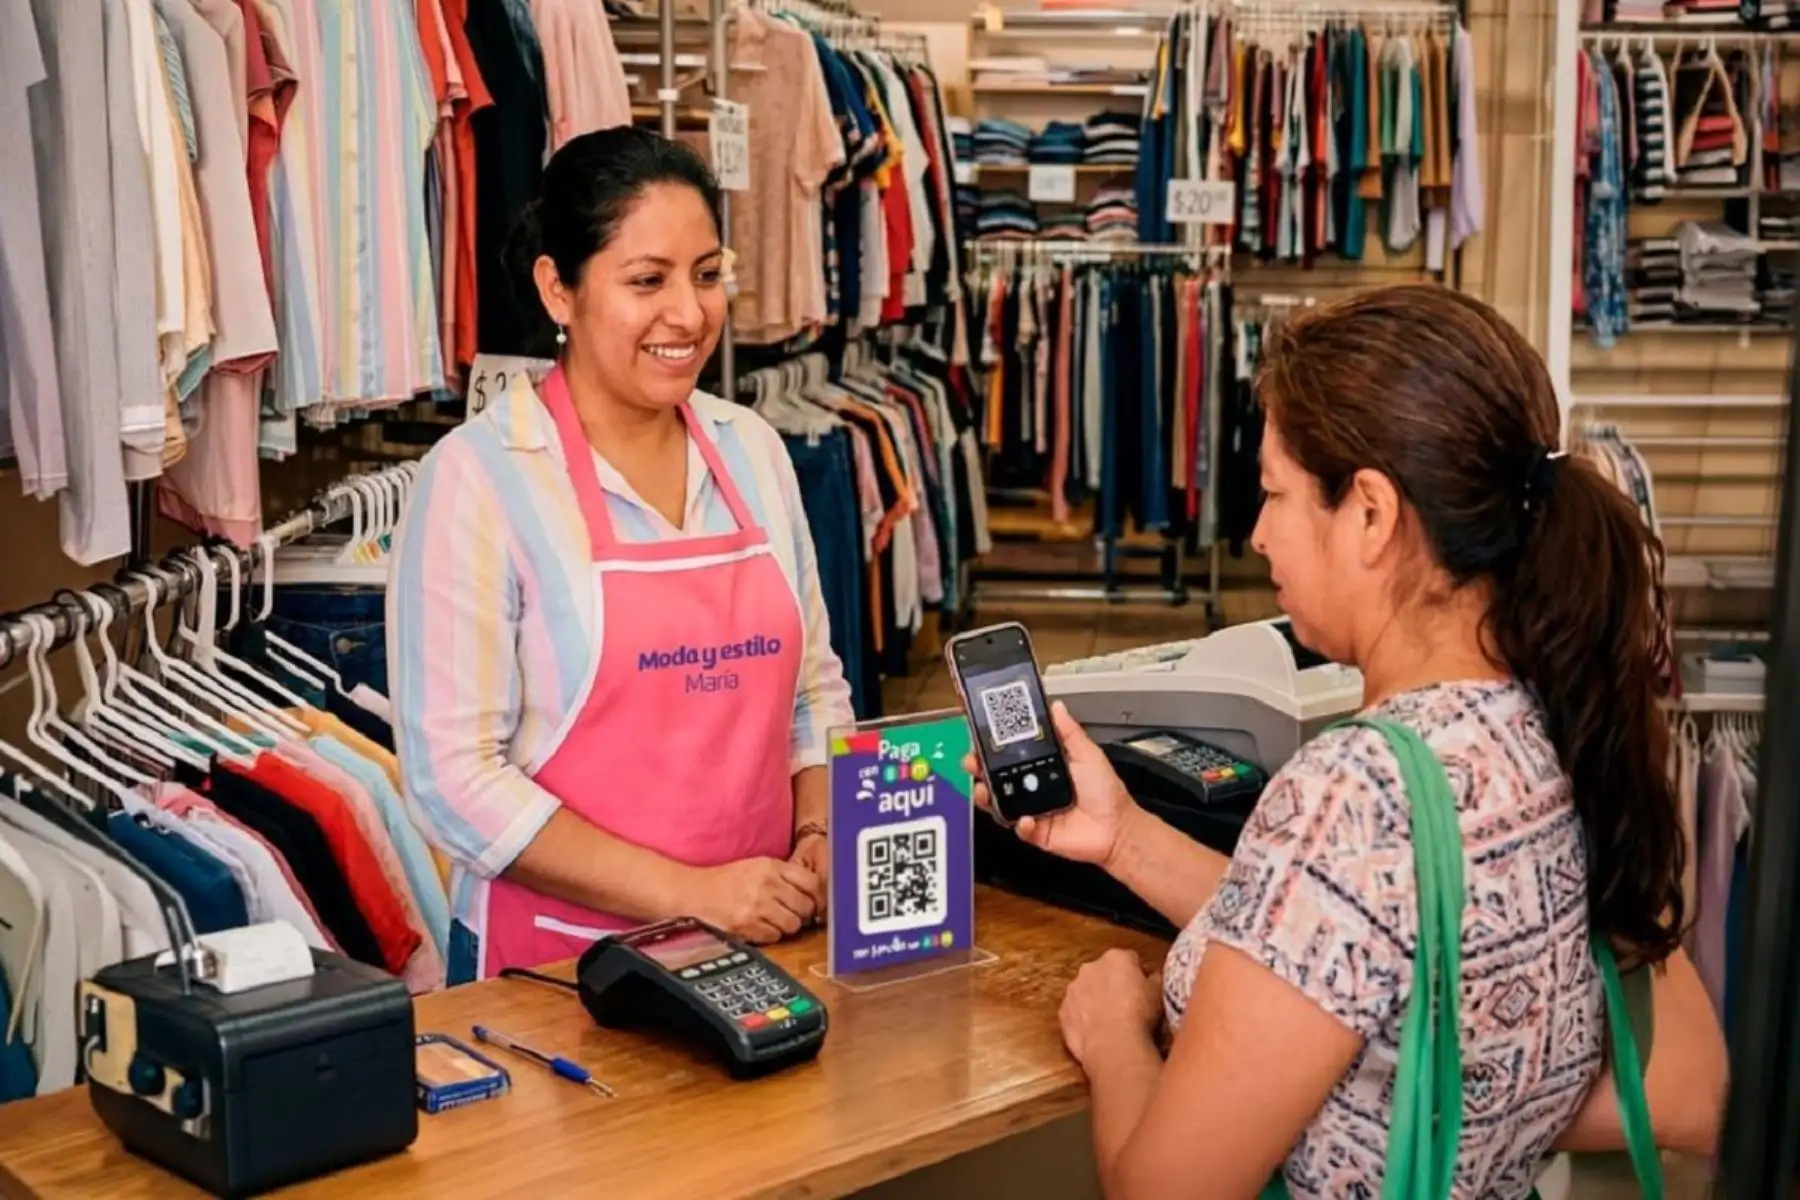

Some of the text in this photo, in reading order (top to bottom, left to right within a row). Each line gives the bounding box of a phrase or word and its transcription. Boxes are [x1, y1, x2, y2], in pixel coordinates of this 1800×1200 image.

[639, 636, 781, 671] Moda y estilo
[685, 669, 738, 693] María
[878, 740, 920, 762] Paga
[878, 775, 936, 816] aquí
